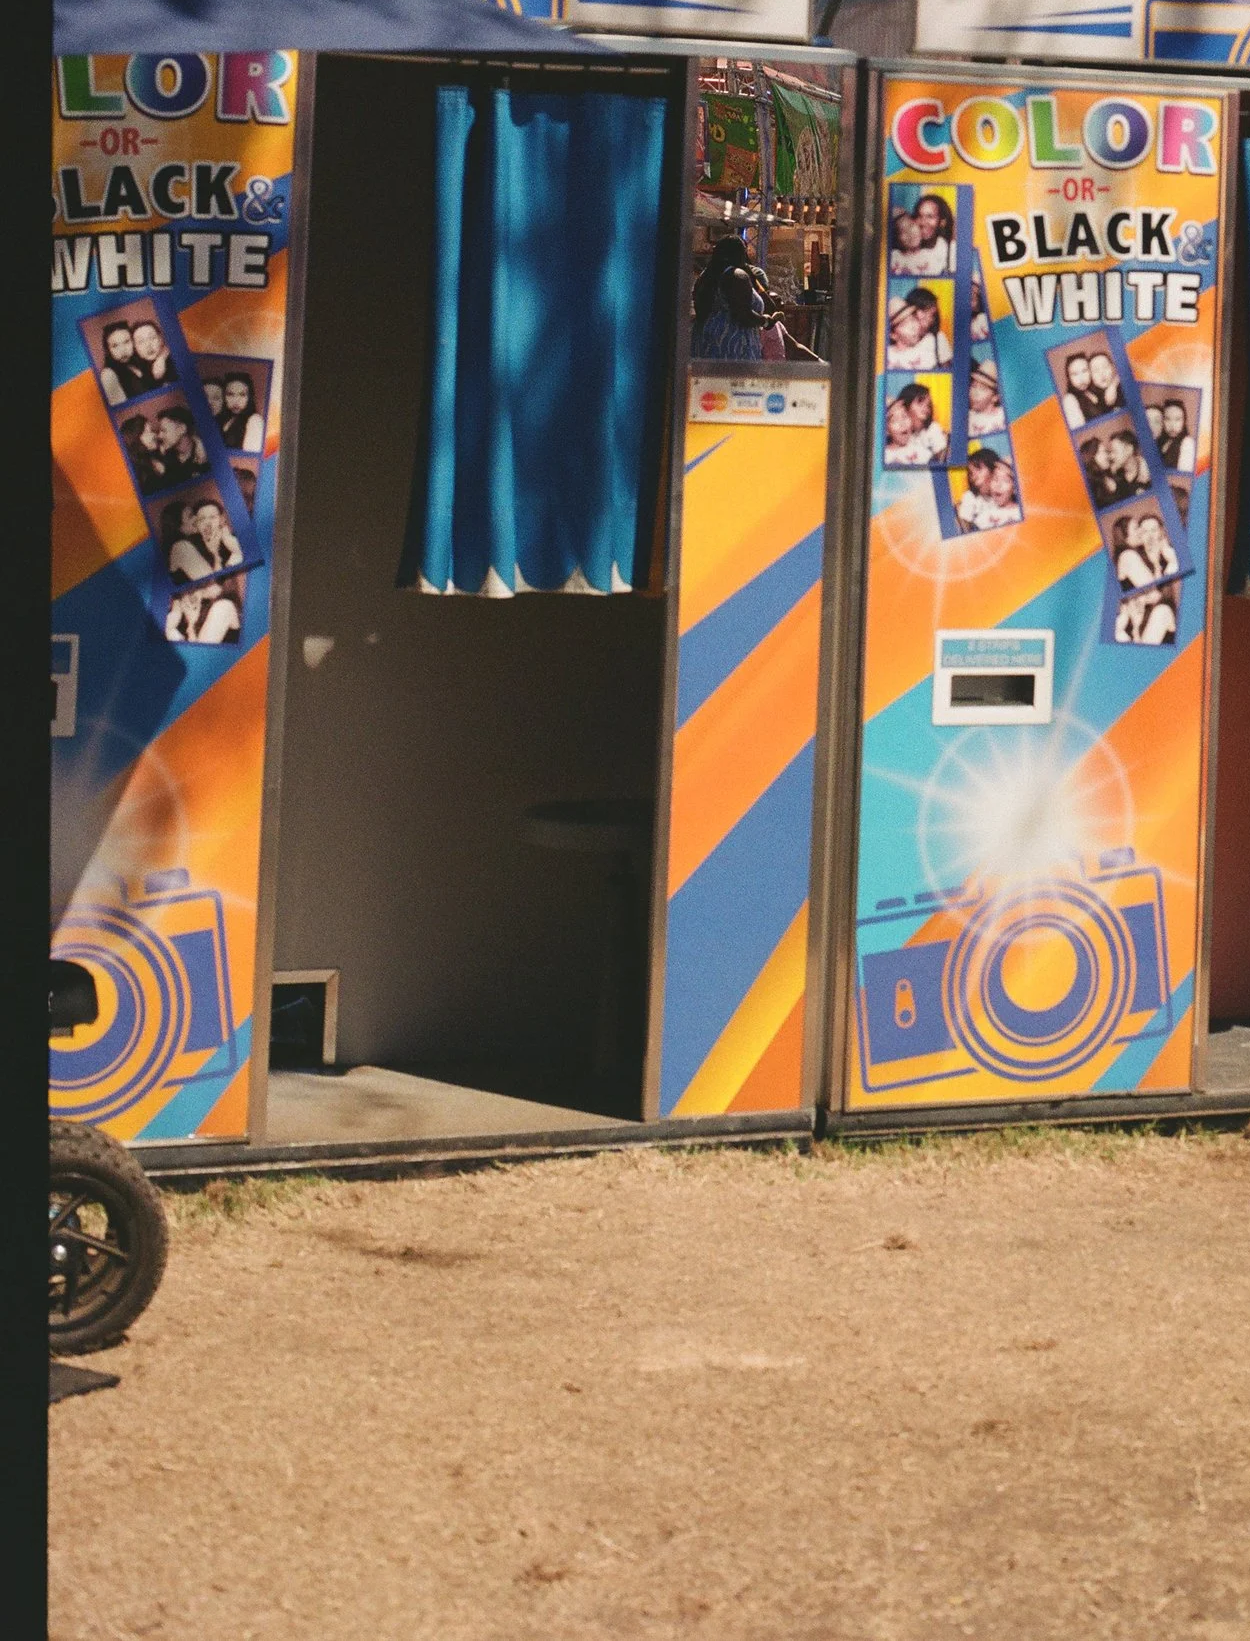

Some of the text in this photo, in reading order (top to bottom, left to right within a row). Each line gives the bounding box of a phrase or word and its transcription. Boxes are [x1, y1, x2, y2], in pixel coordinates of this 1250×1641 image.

[891, 96, 1218, 176] COLOR
[53, 162, 239, 222] LACK
[986, 208, 1176, 269] BLACK
[1003, 270, 1201, 328] WHITE
